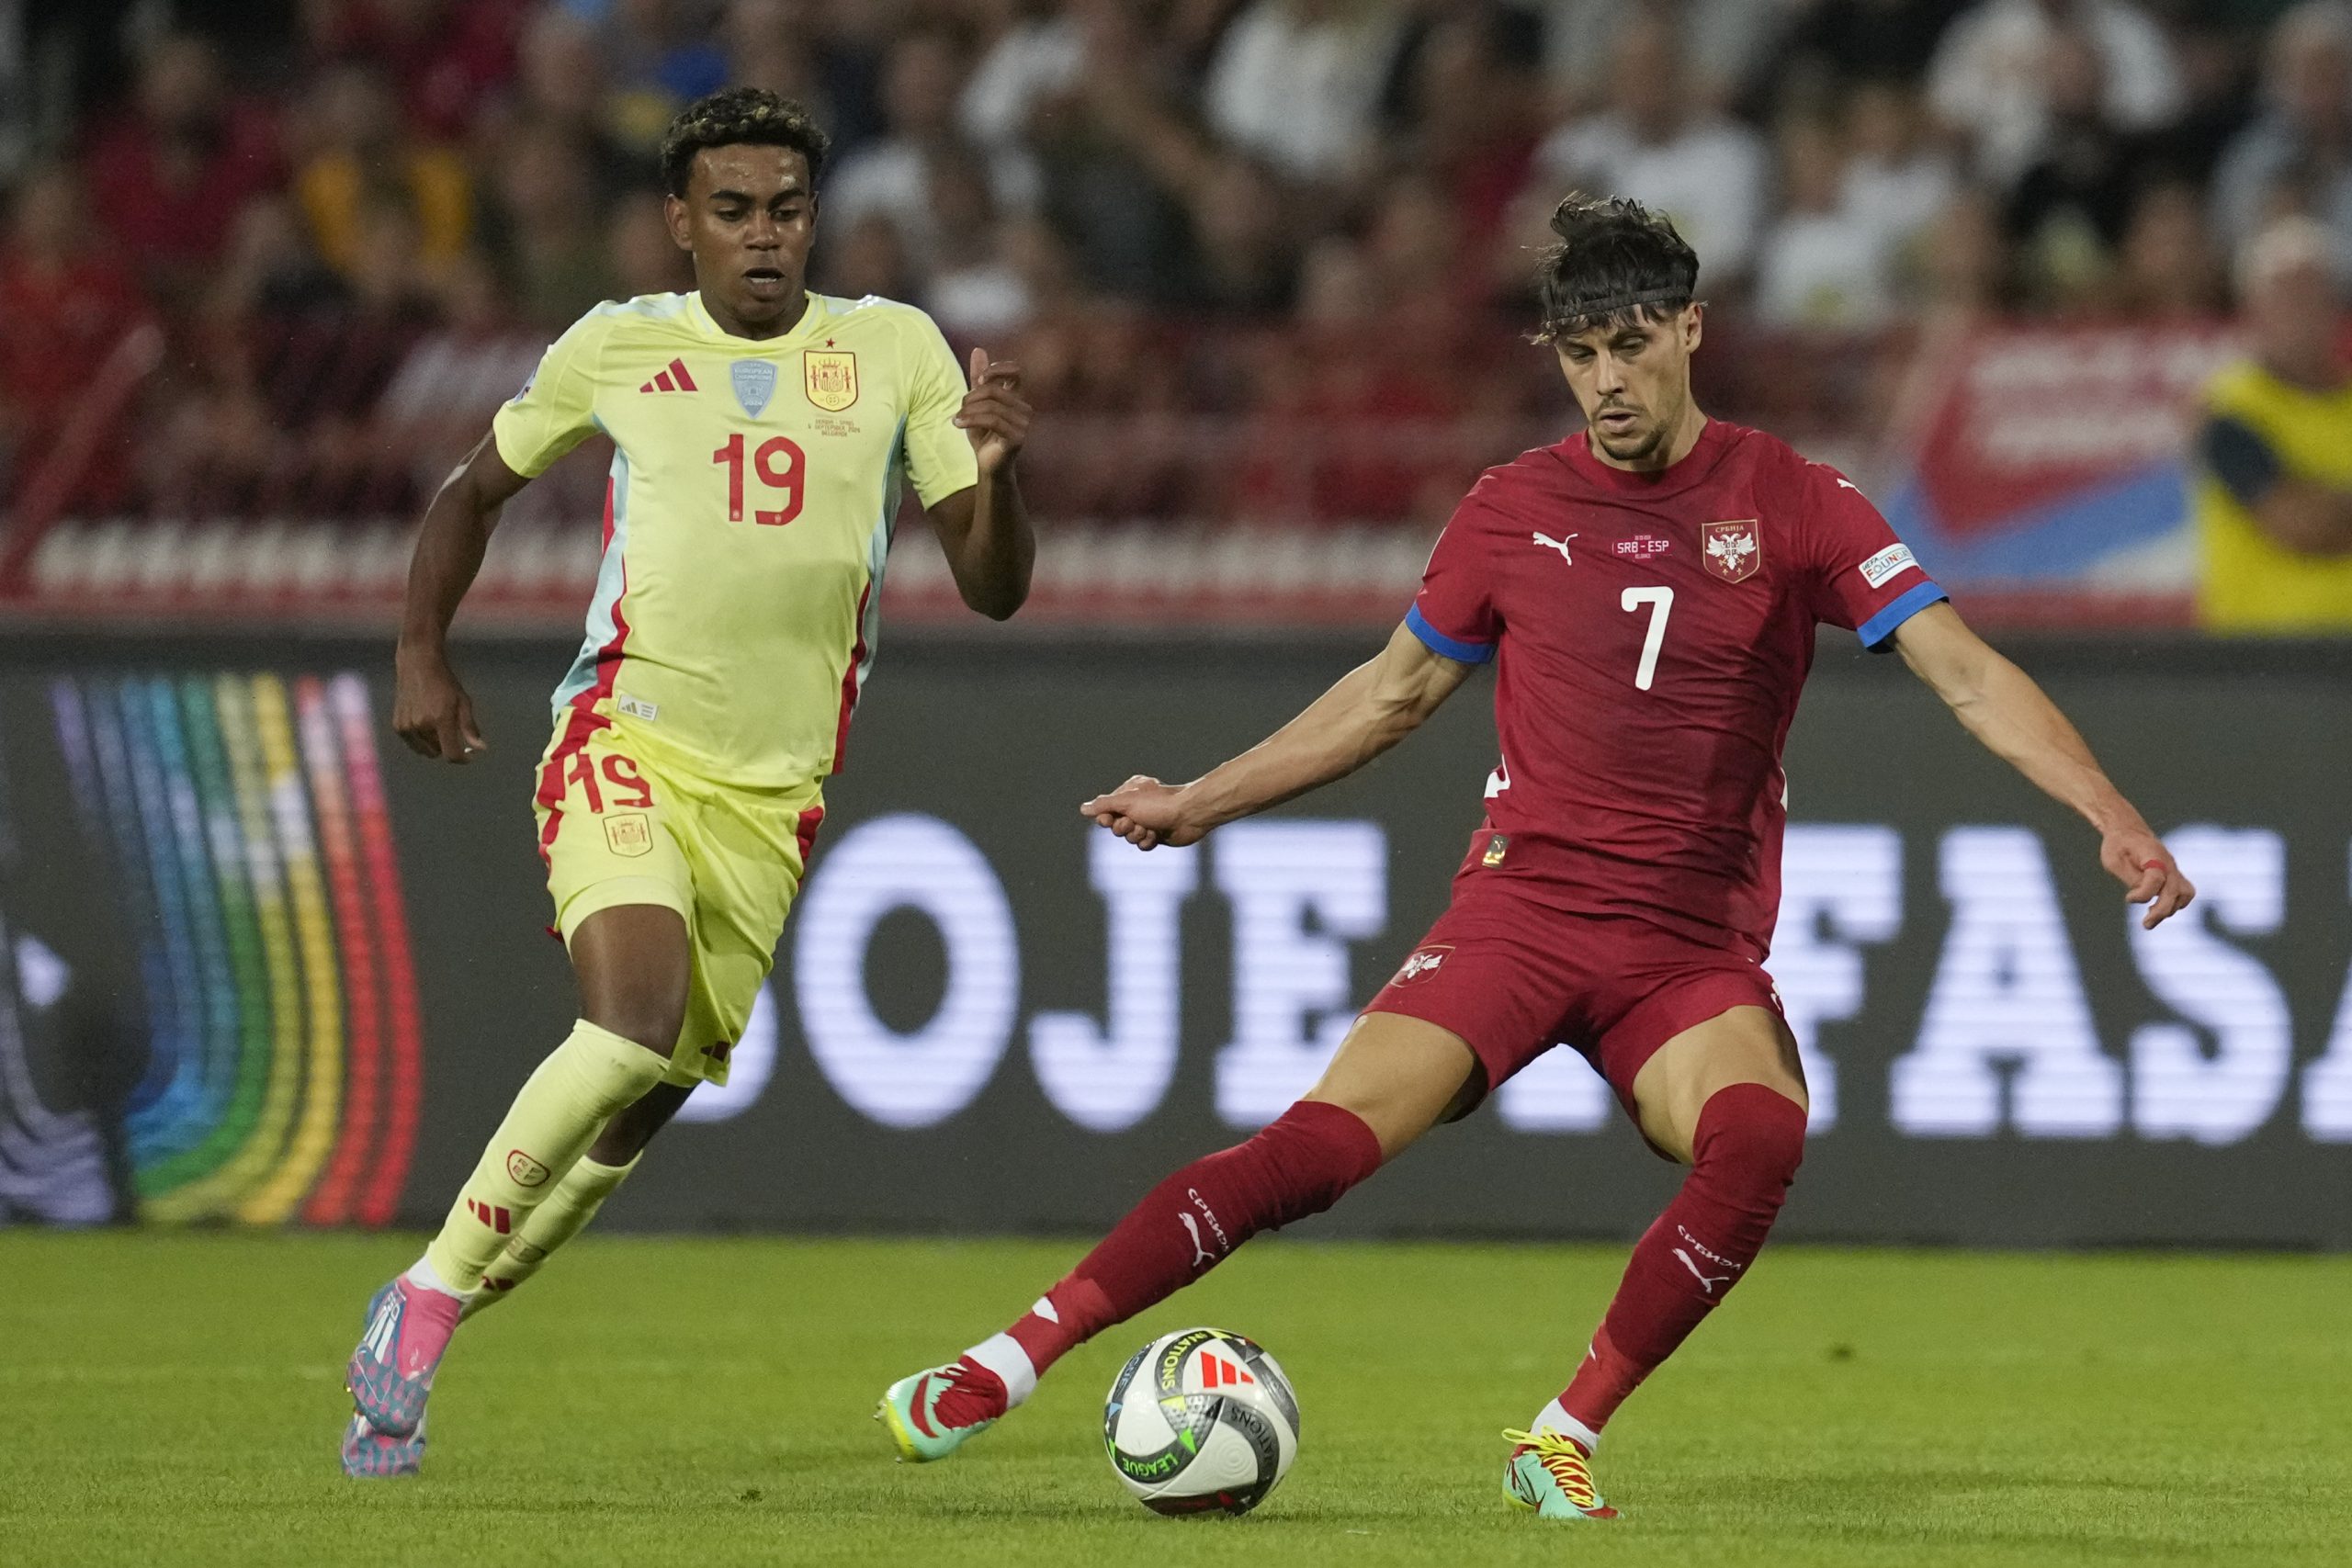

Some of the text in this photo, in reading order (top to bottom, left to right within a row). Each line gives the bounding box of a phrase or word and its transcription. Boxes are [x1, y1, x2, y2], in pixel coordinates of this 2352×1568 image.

[713, 434, 806, 526] 19
[1617, 541, 1639, 554] SRB
[1647, 540, 1670, 552] ESP
[1862, 557, 1879, 570] UEFA
[1865, 549, 1912, 580] FOUNDA
[1621, 586, 1675, 691] 7
[1760, 819, 2352, 1146] FAS
[1161, 1332, 1208, 1391] NATIONS
[1122, 1451, 1180, 1478] LEAGUE
